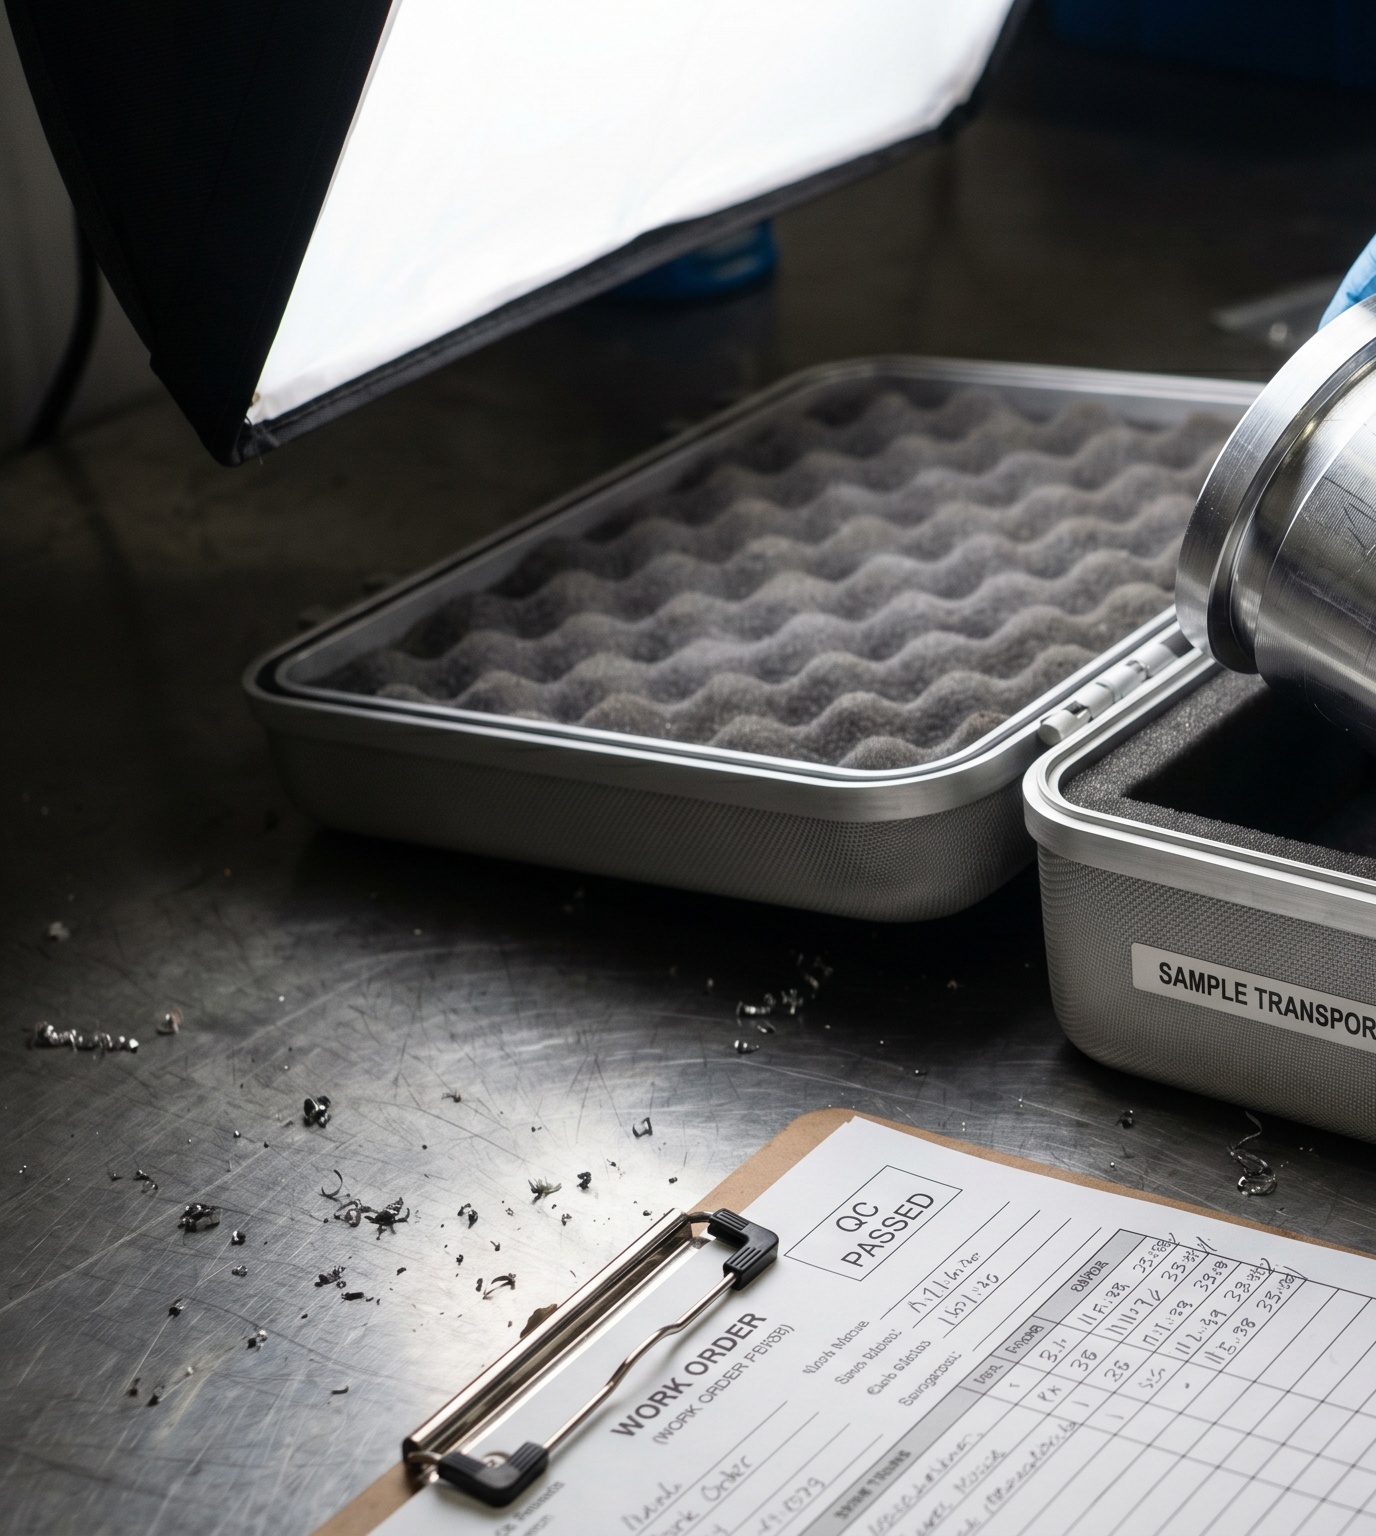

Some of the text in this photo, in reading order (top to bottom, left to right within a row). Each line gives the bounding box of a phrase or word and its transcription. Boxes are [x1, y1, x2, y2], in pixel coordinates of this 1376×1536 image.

[1159, 961, 1248, 1006] SAMPLE
[835, 1201, 879, 1233] QC
[840, 1193, 935, 1268] PASSED
[610, 1377, 694, 1437] WORK
[684, 1312, 768, 1376] ORDER
[652, 1362, 749, 1446] (WORK ORDER
